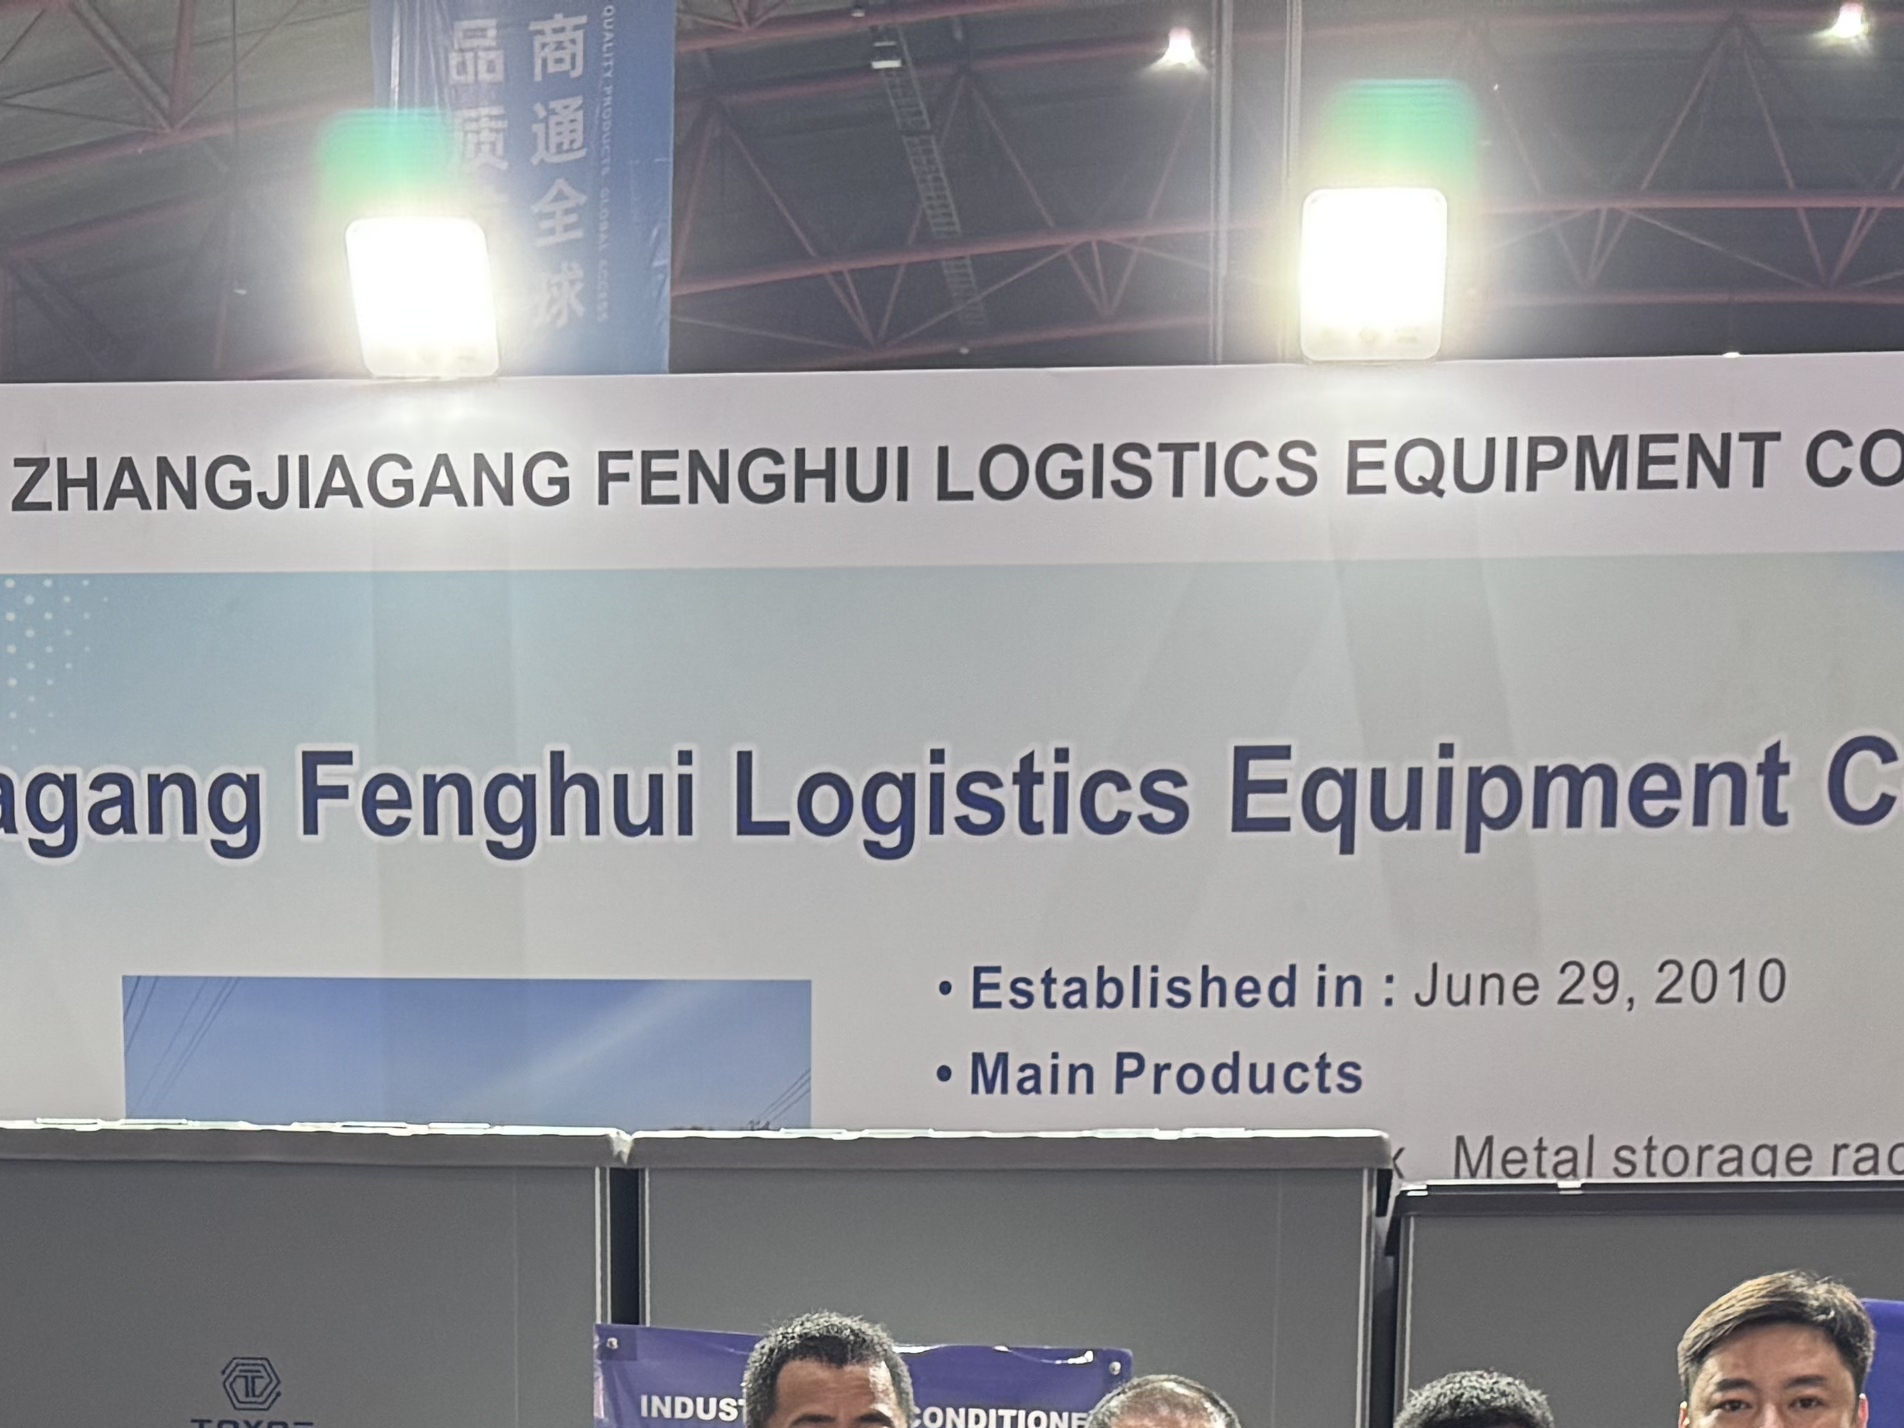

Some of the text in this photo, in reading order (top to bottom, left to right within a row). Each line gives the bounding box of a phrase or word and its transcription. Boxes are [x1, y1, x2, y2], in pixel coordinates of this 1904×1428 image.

[600, 5, 616, 79] QUALITY
[528, 13, 589, 330] 商通全球
[10, 452, 571, 513] ZHANGJIAGANG
[595, 444, 911, 508] FENGHUI
[934, 438, 1320, 503] LOGISTICS
[1343, 430, 1782, 499] EQUIPMENT
[298, 748, 696, 859] Fenghui
[733, 745, 1192, 861] Logistics
[1230, 741, 1793, 855] Equipment
[971, 963, 1299, 1011] Established
[1314, 964, 1365, 1009] in
[1414, 960, 1541, 1009] June
[1556, 958, 1638, 1013] 29,
[1655, 956, 1789, 1007] 2010
[970, 1048, 1365, 1100] Main Products
[1454, 1134, 1595, 1179] Metal
